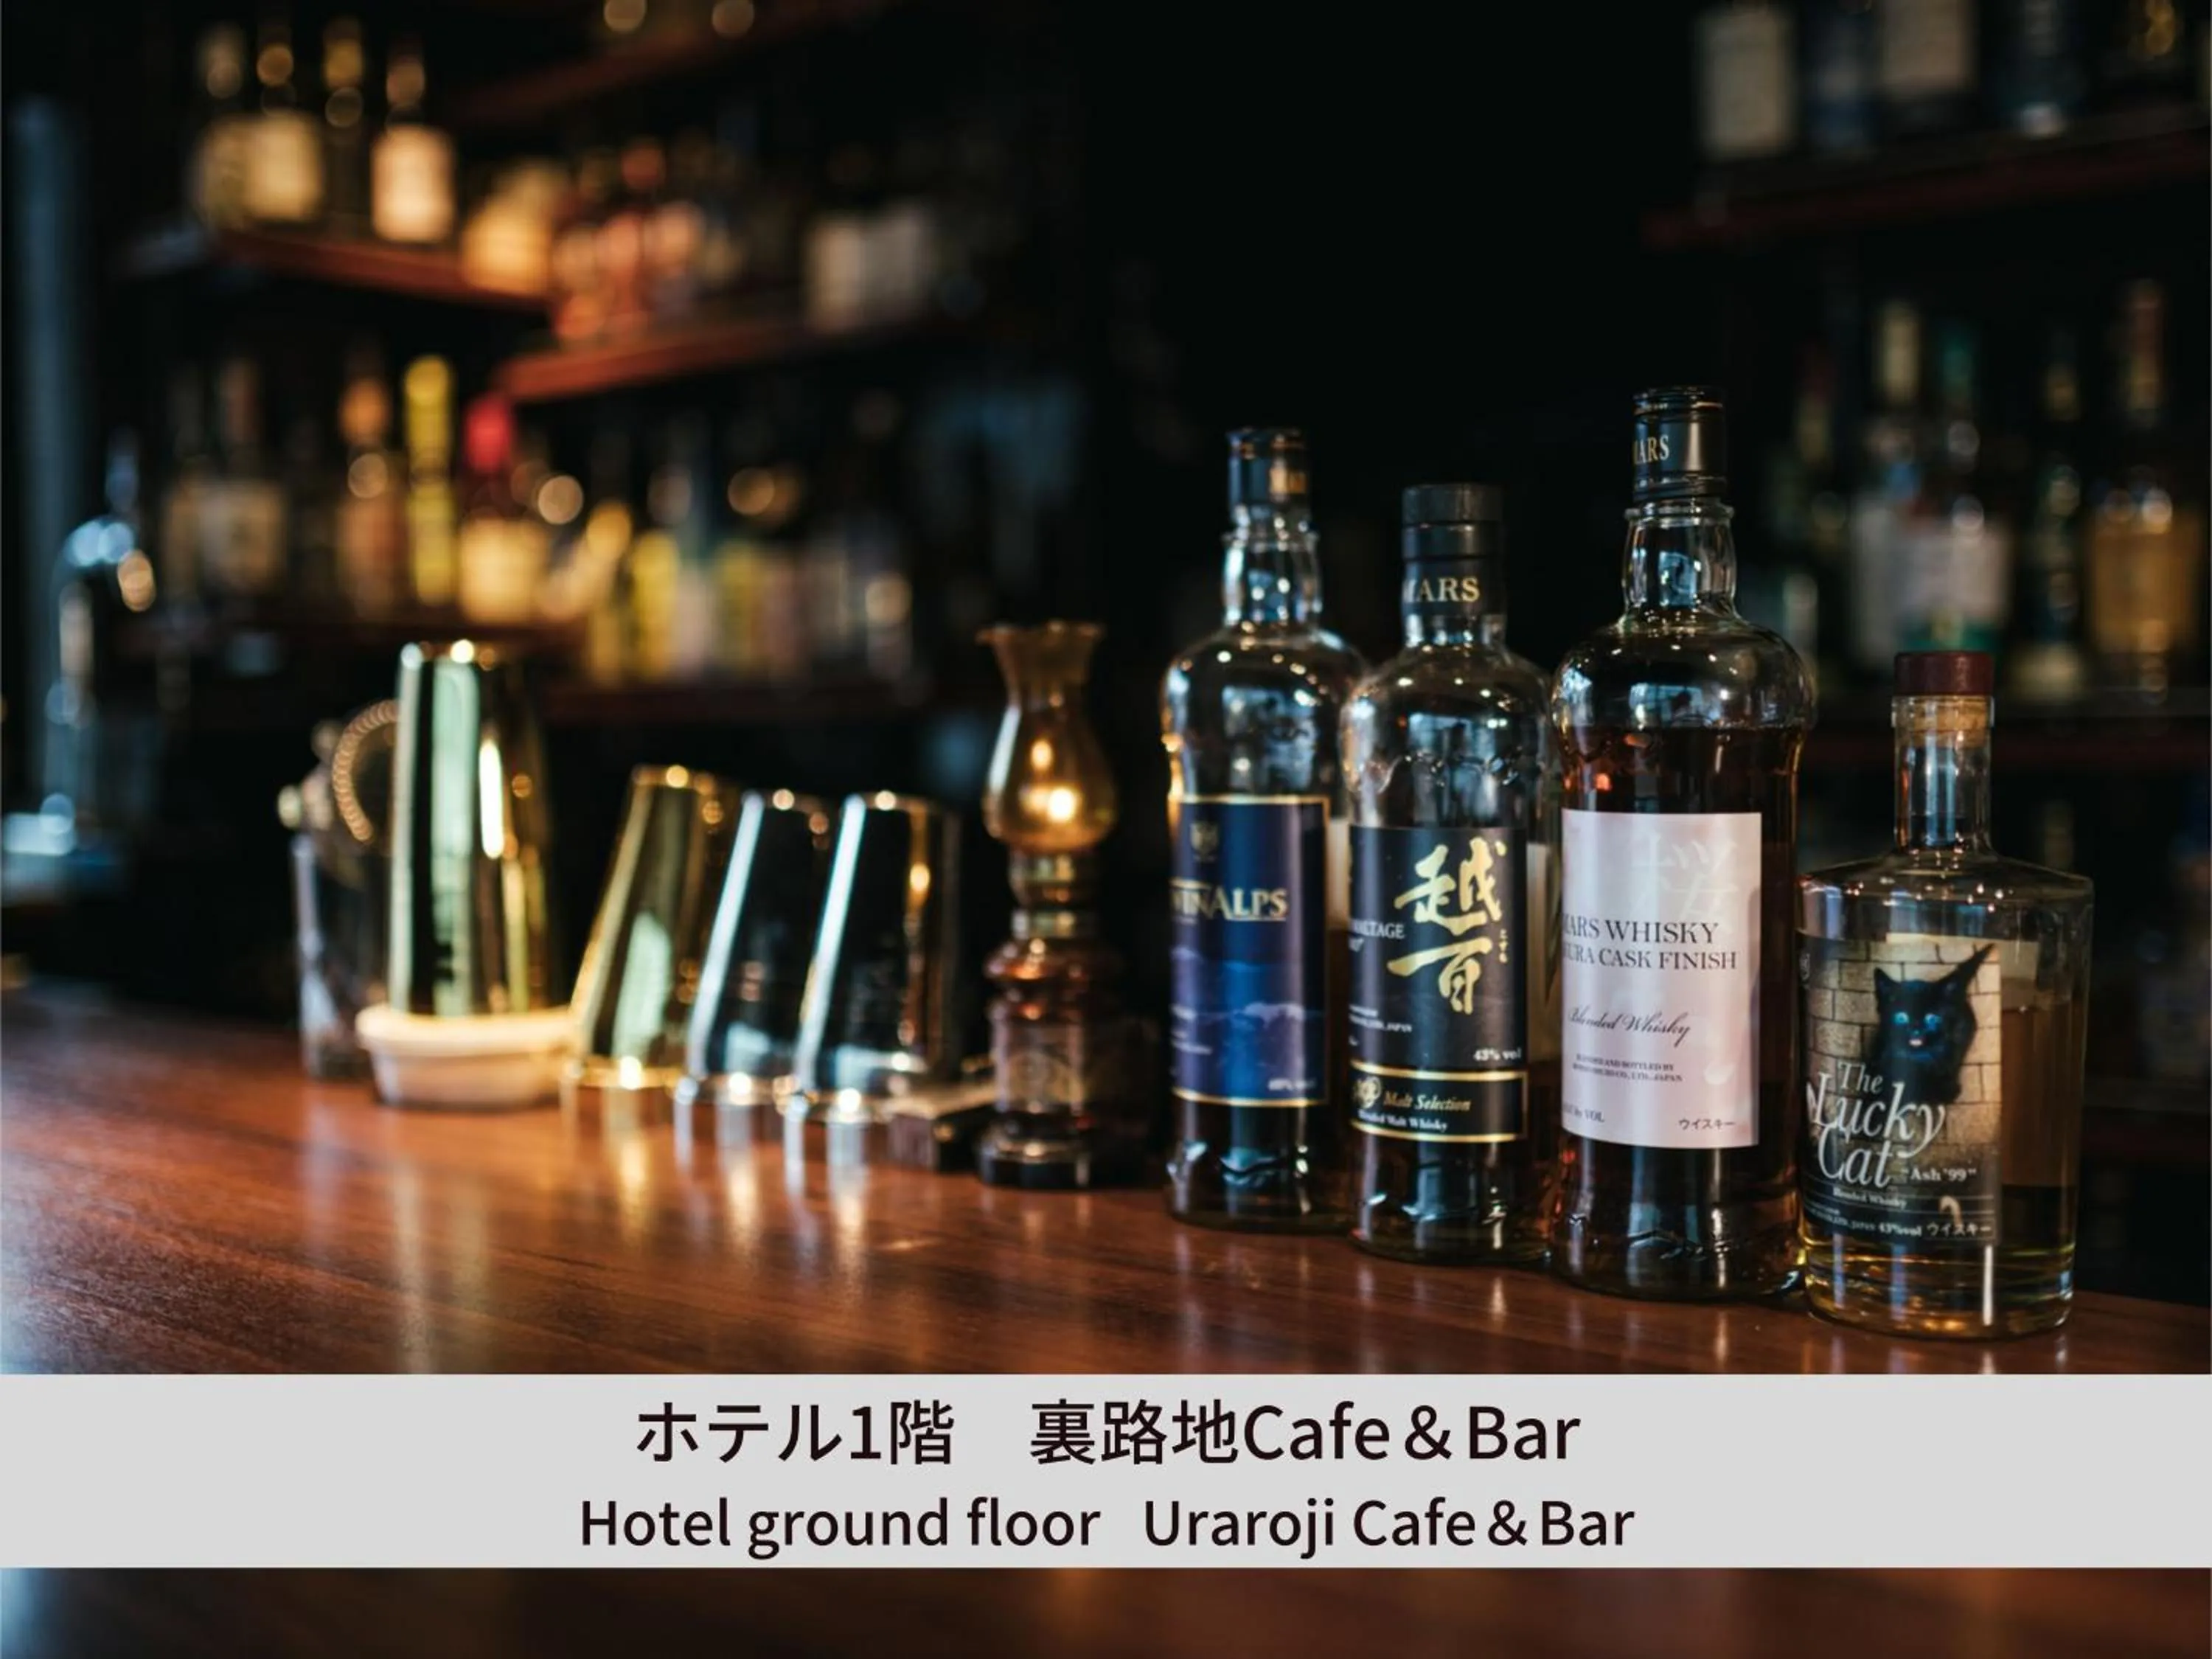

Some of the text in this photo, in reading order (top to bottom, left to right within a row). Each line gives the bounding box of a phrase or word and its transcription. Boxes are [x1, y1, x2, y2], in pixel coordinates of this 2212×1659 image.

[1604, 919, 1719, 944] WHISKY
[1598, 947, 1652, 968] CASK
[1658, 950, 1739, 970] FINISH
[1569, 1006, 1691, 1048] Blended Whisky
[1837, 1060, 1884, 1095] The
[1414, 1093, 1472, 1112] Selection
[1806, 1071, 1946, 1158] Lucky
[1678, 1117, 1736, 1130] ウイスキー
[1818, 1123, 1893, 1189] Cat
